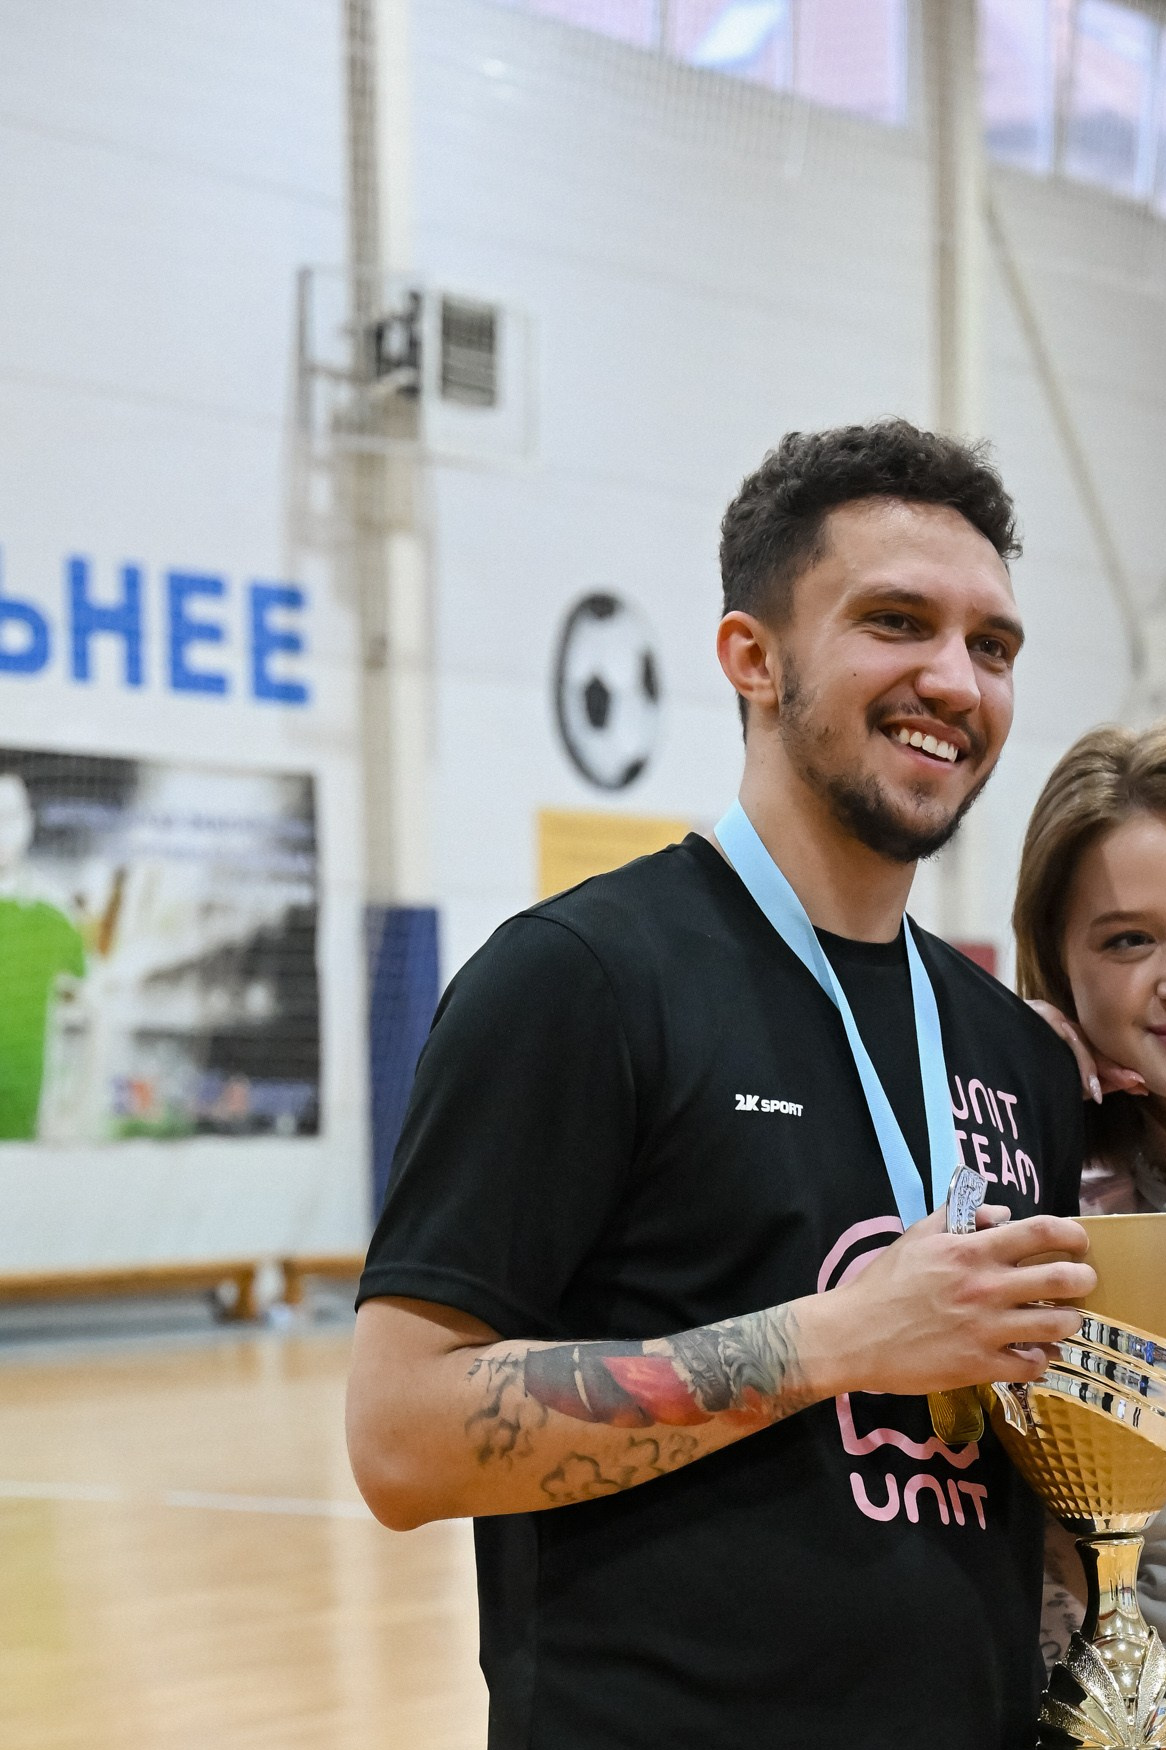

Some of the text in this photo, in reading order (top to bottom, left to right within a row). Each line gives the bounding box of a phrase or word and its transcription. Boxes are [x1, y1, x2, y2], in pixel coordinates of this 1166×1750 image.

[735, 1094, 804, 1117] 2K SPORT
[950, 1074, 1018, 1141] UNIT
[849, 1471, 988, 1531] UNIT
